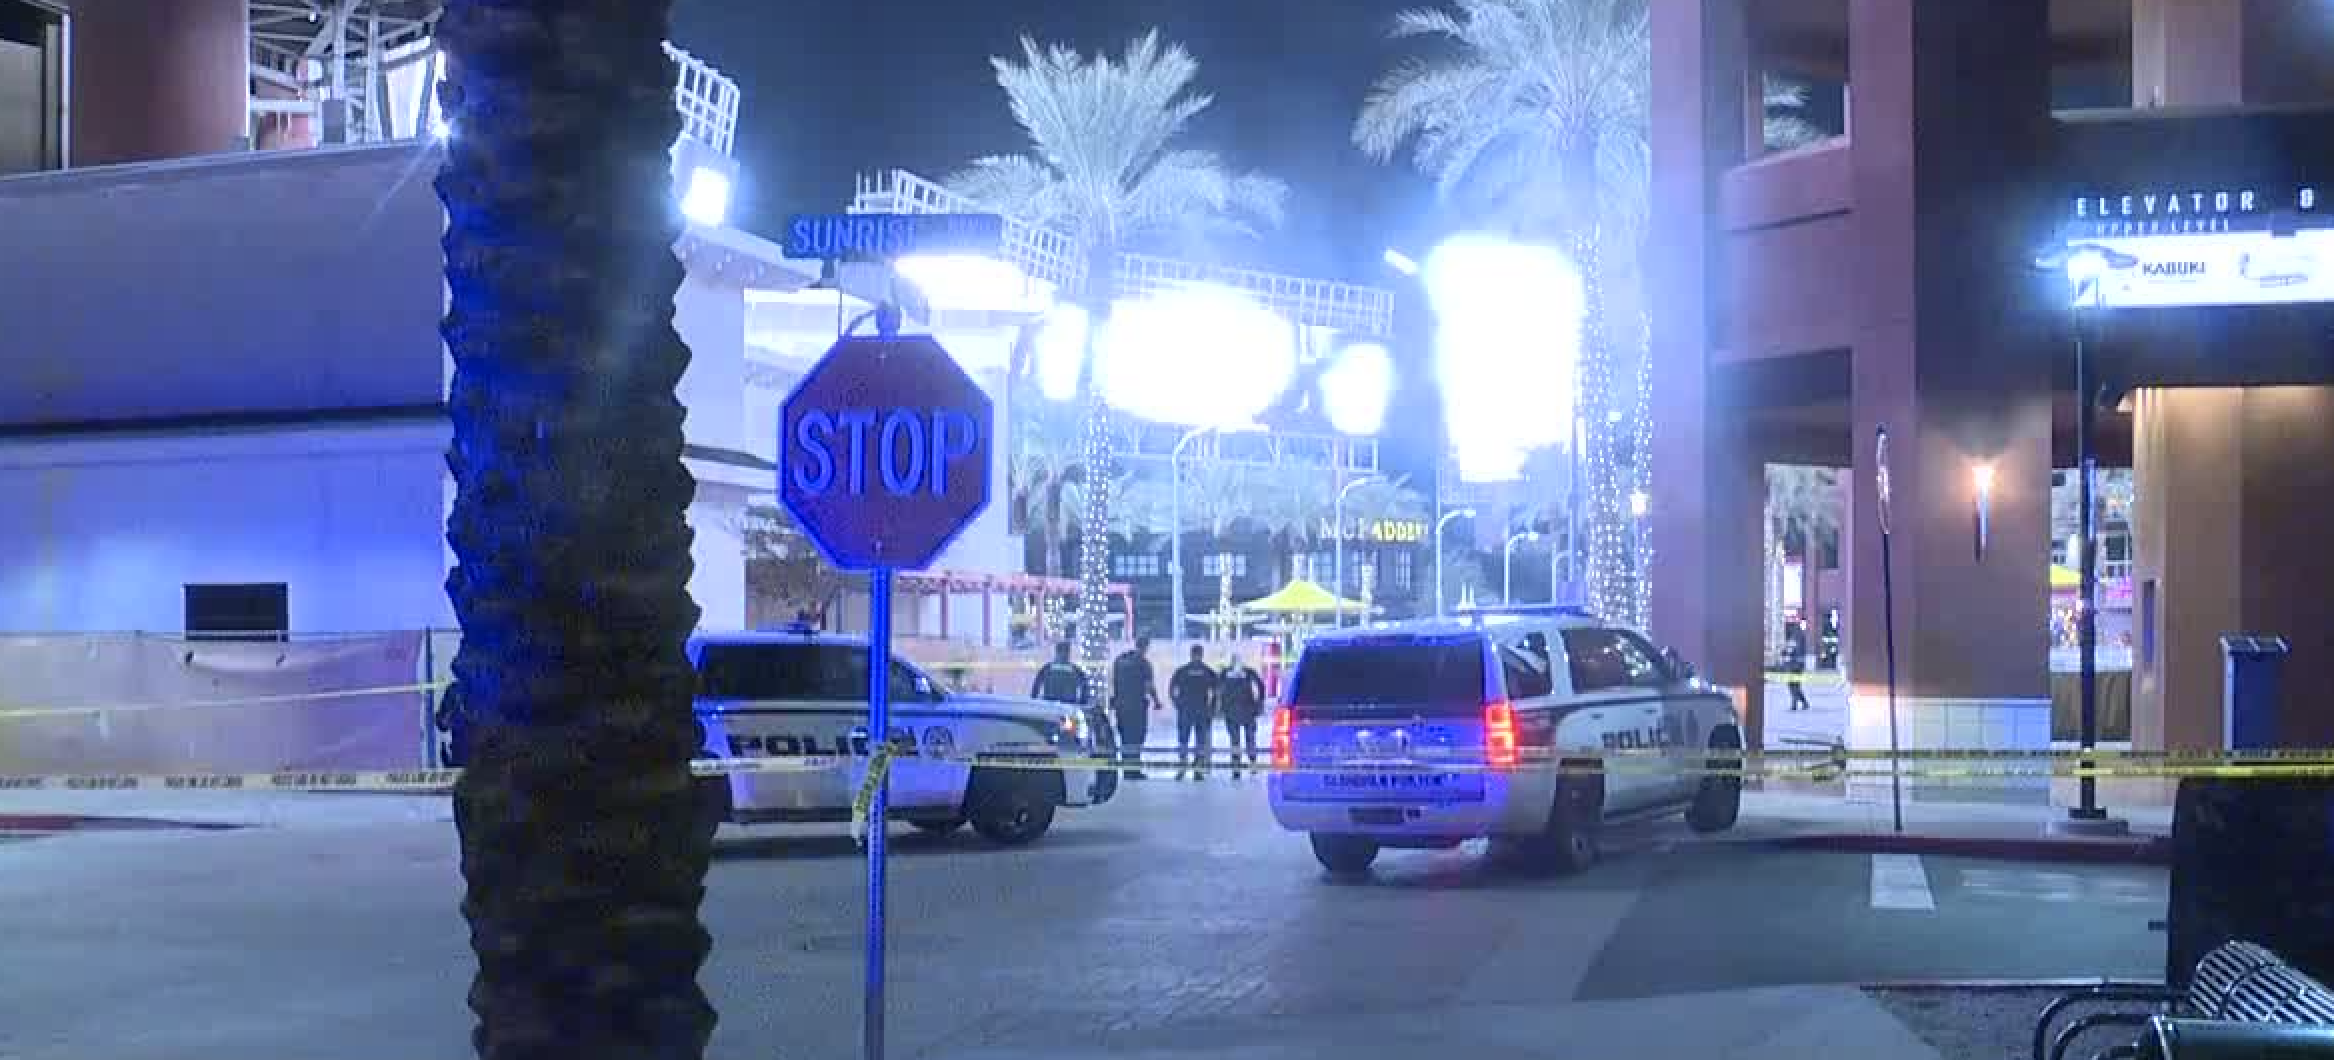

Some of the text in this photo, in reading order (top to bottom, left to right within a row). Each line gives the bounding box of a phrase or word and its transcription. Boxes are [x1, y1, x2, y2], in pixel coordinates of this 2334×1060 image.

[2077, 190, 2255, 216] ELEVATOR
[2142, 261, 2207, 277] KABUKI
[793, 409, 976, 496] STOP
